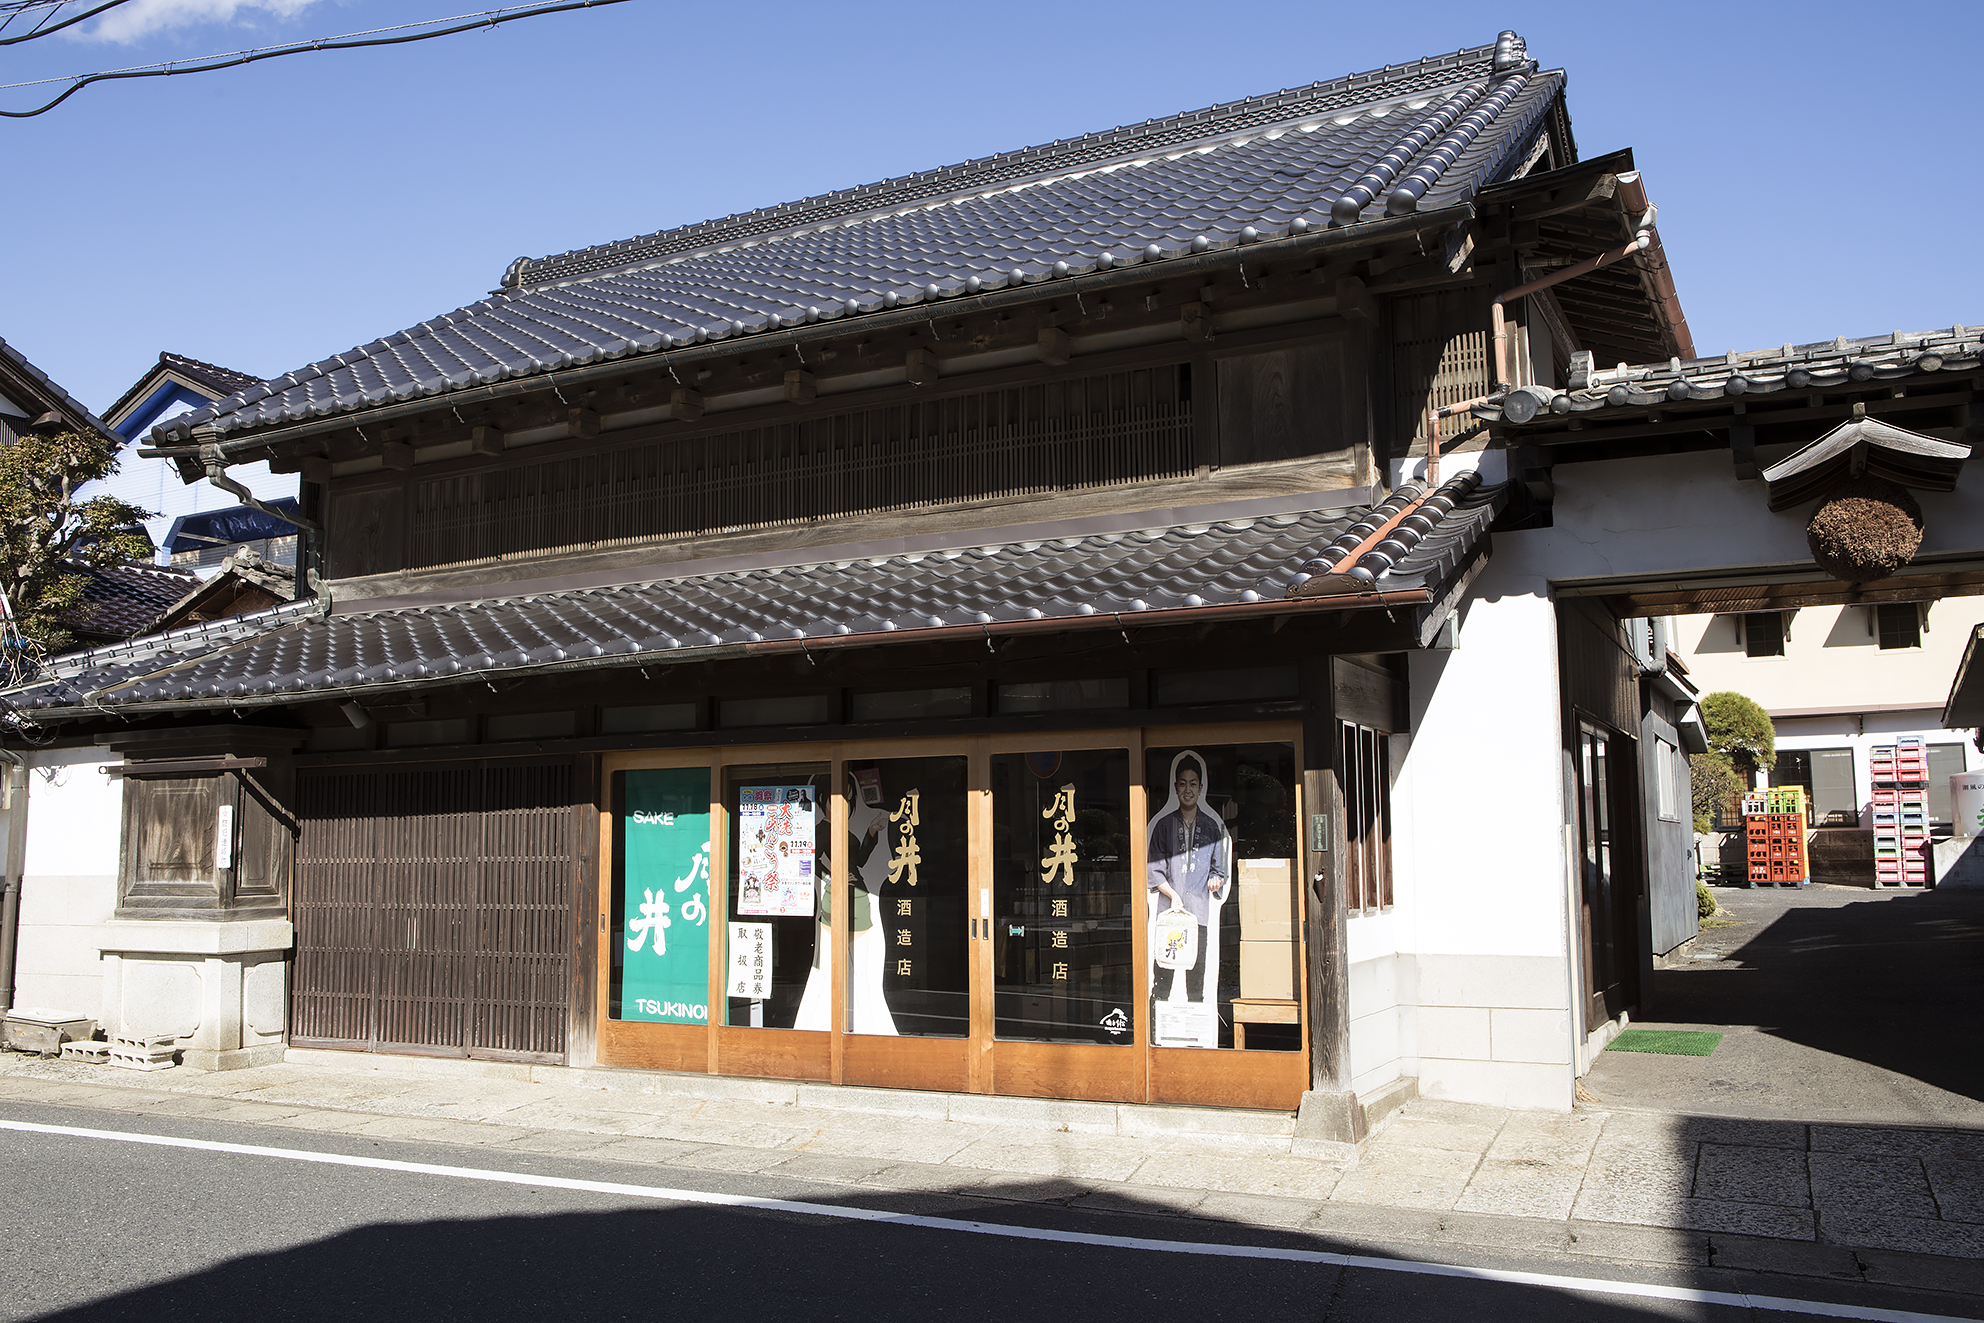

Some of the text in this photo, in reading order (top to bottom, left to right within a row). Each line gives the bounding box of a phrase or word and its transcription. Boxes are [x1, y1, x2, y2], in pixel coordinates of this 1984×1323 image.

[633, 810, 674, 826] SAKE
[778, 802, 793, 834] 大洗
[763, 812, 779, 892] あんこう祭
[888, 787, 921, 976] 月の井 酒造店
[1041, 782, 1078, 980] 月の井 酒造店
[736, 928, 748, 993] 取扱店
[753, 928, 764, 994] 敬老商品券
